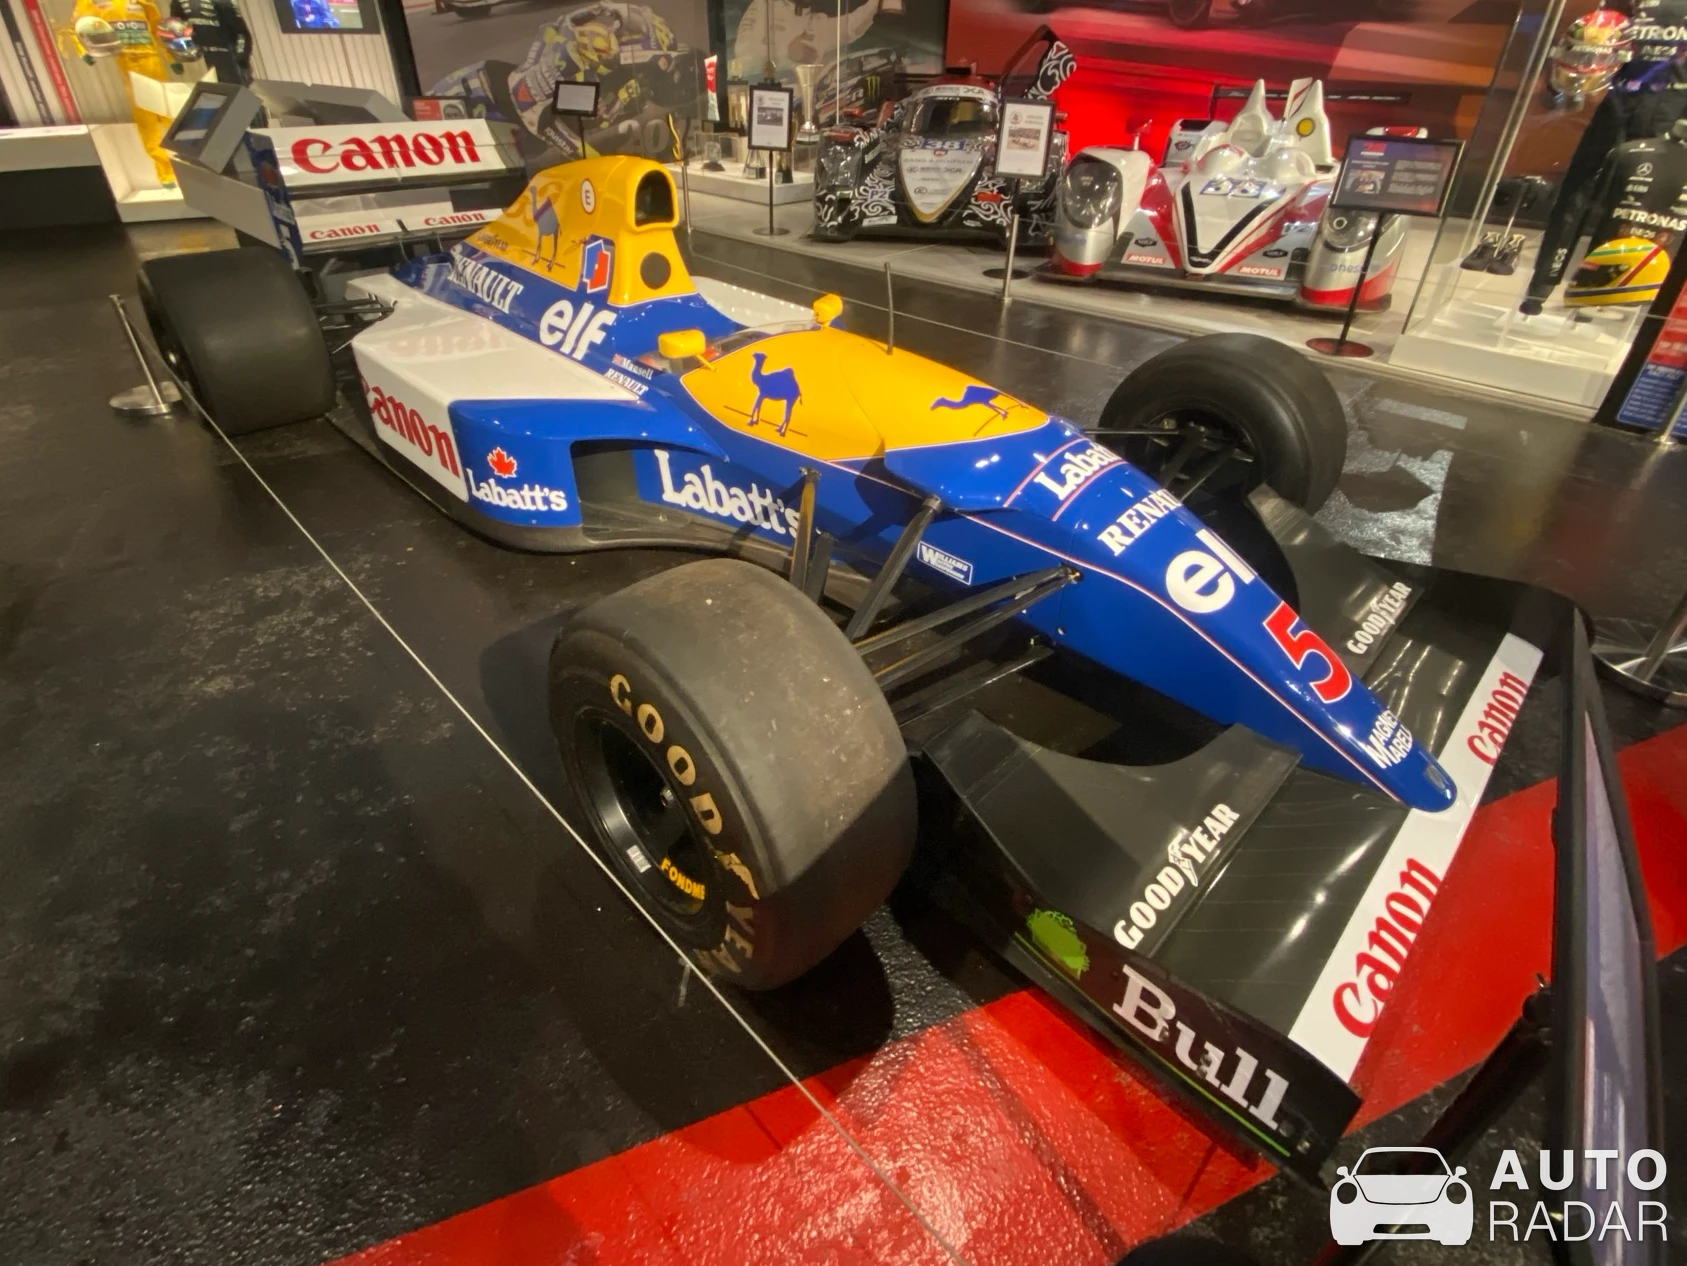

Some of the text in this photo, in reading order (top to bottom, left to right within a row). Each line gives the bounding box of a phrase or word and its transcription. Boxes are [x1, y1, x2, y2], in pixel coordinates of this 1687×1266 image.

[291, 130, 481, 174] Canon
[310, 223, 380, 240] Canon
[424, 211, 485, 227] Canon
[1613, 207, 1687, 231] PETRONAS
[1128, 255, 1164, 264] MOTUL
[1240, 266, 1280, 276] MOTUL
[540, 300, 617, 361] elf
[604, 368, 649, 396] RENAULT
[466, 468, 568, 512] Labatt's
[654, 449, 802, 540] Labatt's
[1262, 600, 1353, 704] 5
[1467, 671, 1530, 767] Canon
[1332, 857, 1442, 1038] Canon
[1112, 963, 1290, 1131] Bull
